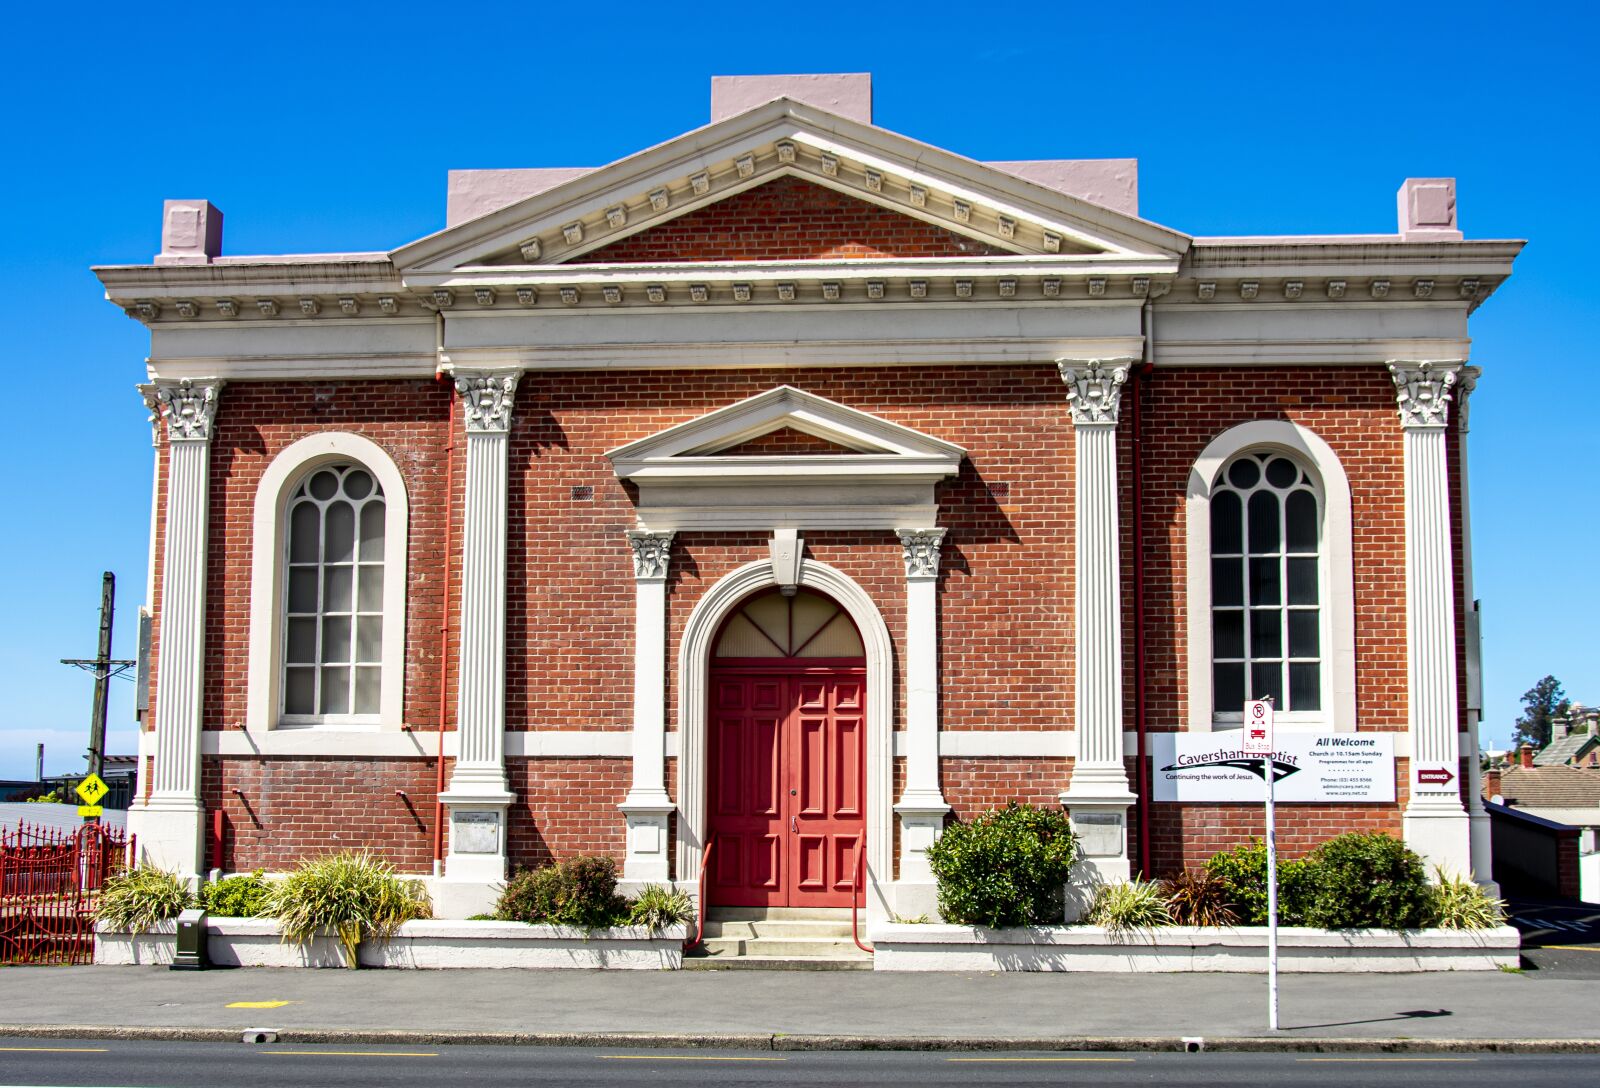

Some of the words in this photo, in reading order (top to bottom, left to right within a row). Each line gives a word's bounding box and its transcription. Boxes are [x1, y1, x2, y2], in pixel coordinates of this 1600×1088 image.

[1316, 738, 1330, 747] All
[1331, 738, 1376, 747] Welcome
[1178, 749, 1249, 766] Caversham
[1165, 773, 1201, 782] Continuing
